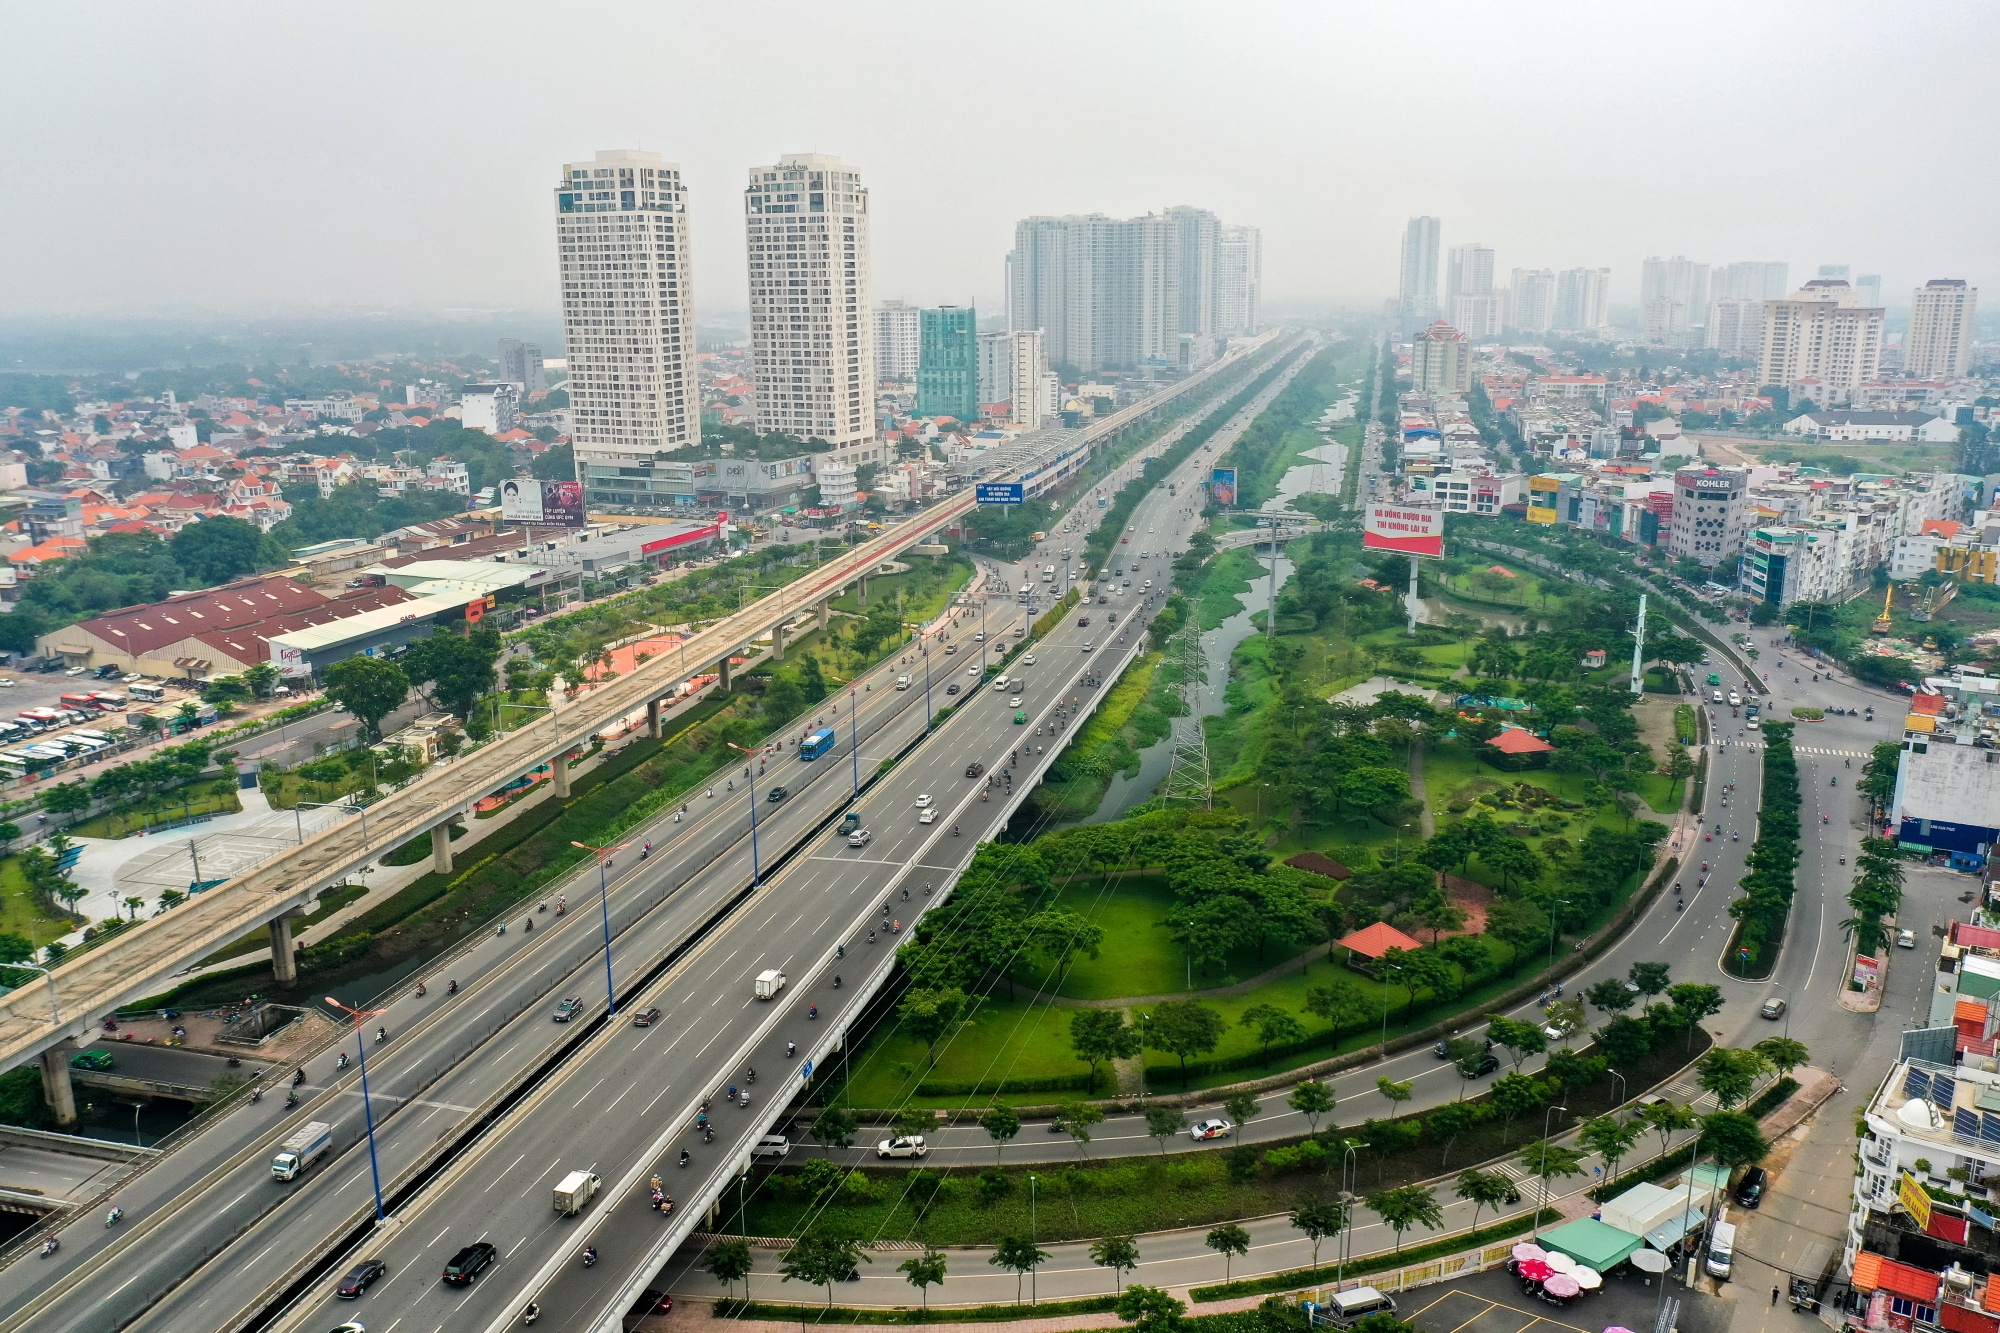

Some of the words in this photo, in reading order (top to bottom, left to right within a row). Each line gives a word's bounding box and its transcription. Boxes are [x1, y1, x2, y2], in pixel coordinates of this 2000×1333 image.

[1696, 480, 1730, 488] KOHLER
[1384, 510, 1400, 519] UỐNG
[1402, 512, 1420, 522] RƯỢU
[1421, 514, 1432, 522] BIA
[1388, 522, 1408, 531] KHÔNG
[1410, 524, 1420, 532] LÁI
